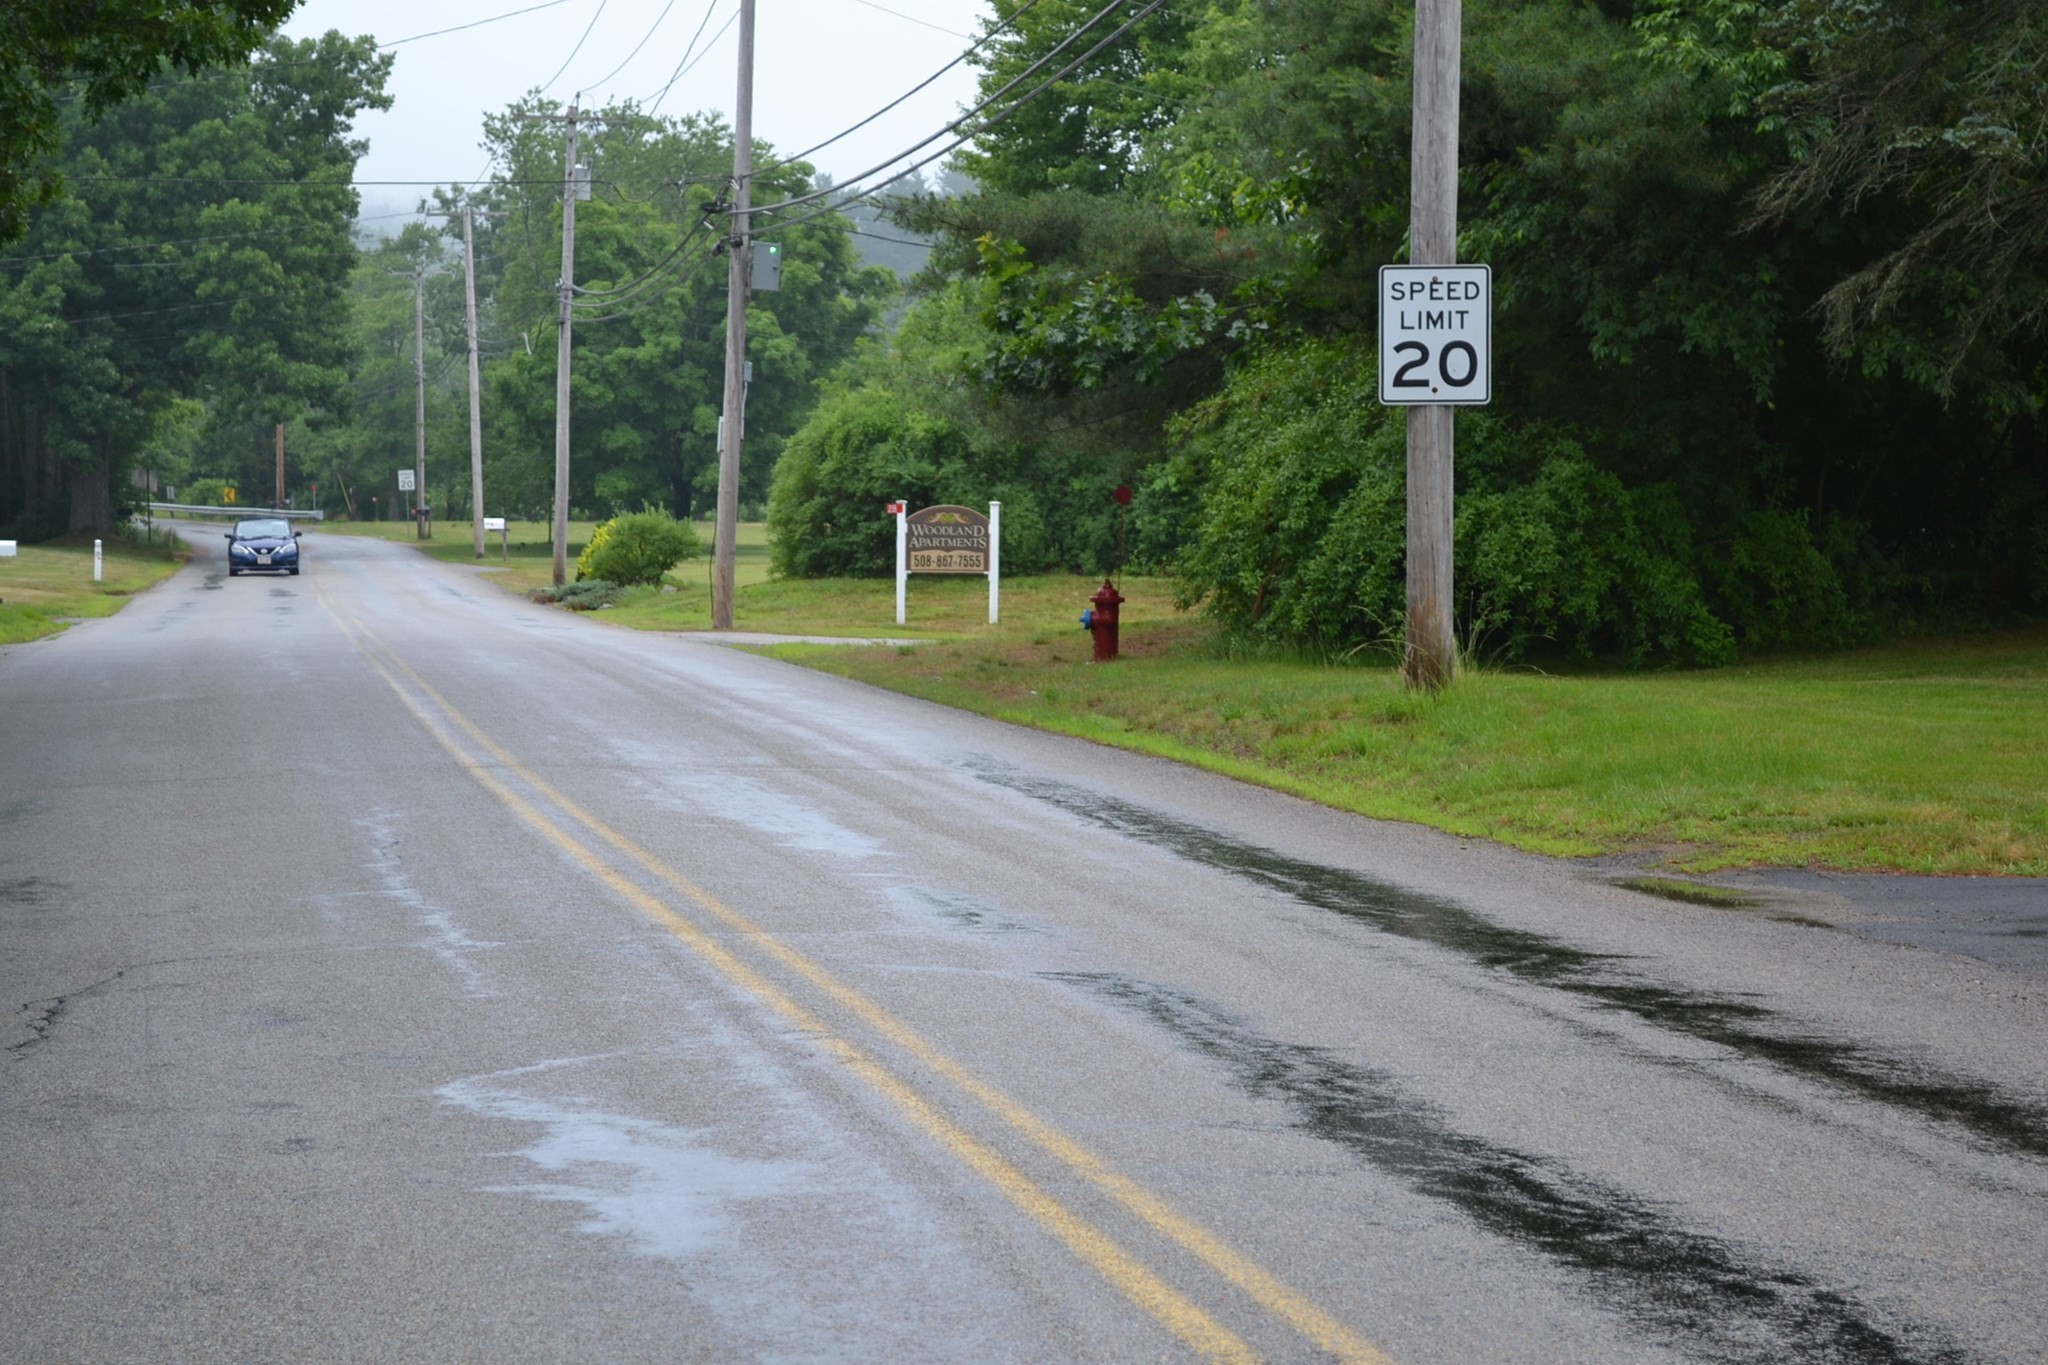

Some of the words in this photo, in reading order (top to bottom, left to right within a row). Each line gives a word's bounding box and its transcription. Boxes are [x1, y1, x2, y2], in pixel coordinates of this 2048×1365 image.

[1391, 281, 1480, 301] SPEED
[1401, 310, 1469, 330] LIMIT
[1393, 340, 1478, 388] 20
[401, 480, 413, 488] 20
[911, 524, 984, 537] WOODLAND
[909, 537, 987, 549] APARTMENTS
[914, 555, 981, 568] 508-867-7555
